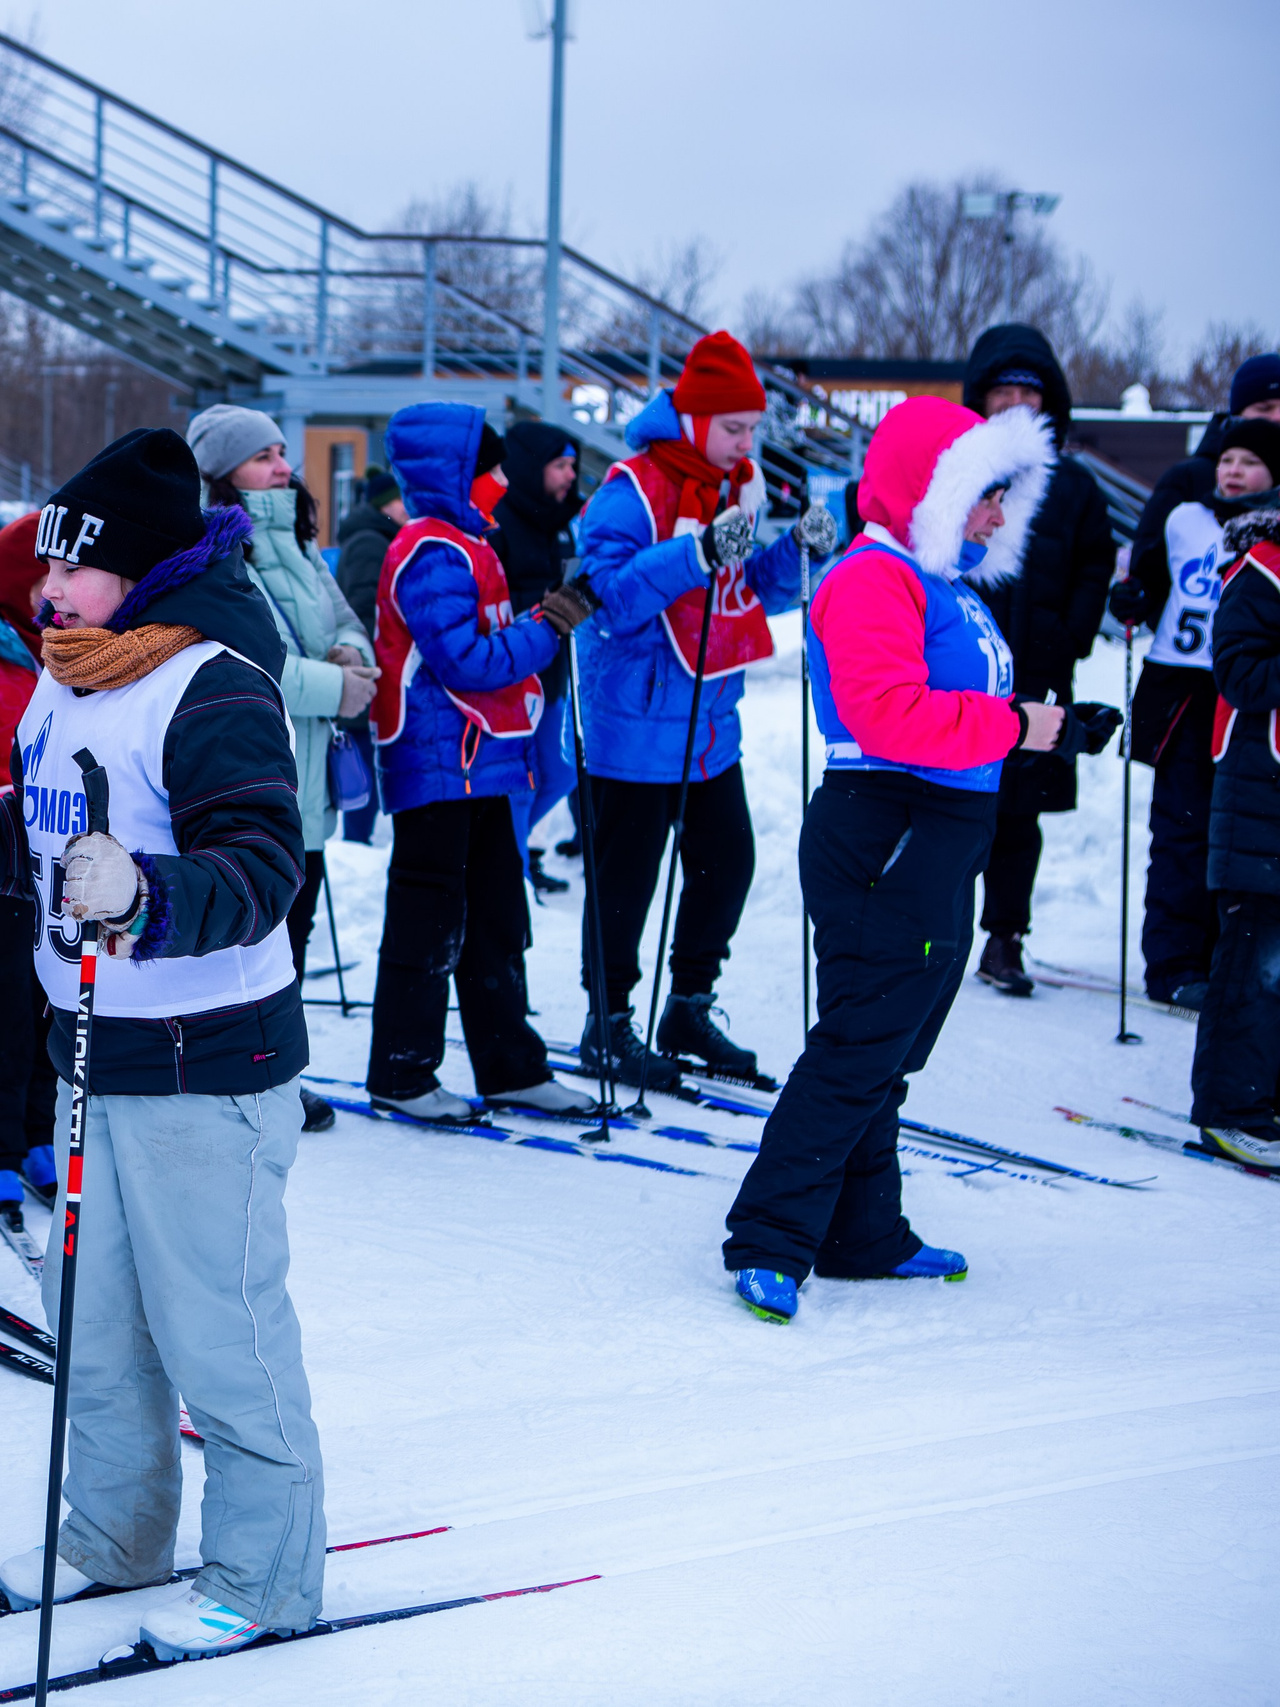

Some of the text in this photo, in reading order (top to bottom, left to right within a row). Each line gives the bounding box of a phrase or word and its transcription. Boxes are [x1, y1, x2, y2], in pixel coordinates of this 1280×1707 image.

[35, 504, 104, 563] OLF
[38, 785, 87, 836] МОЭ
[713, 1072, 756, 1089] NORDWAY
[10, 1353, 55, 1376] ACTIV
